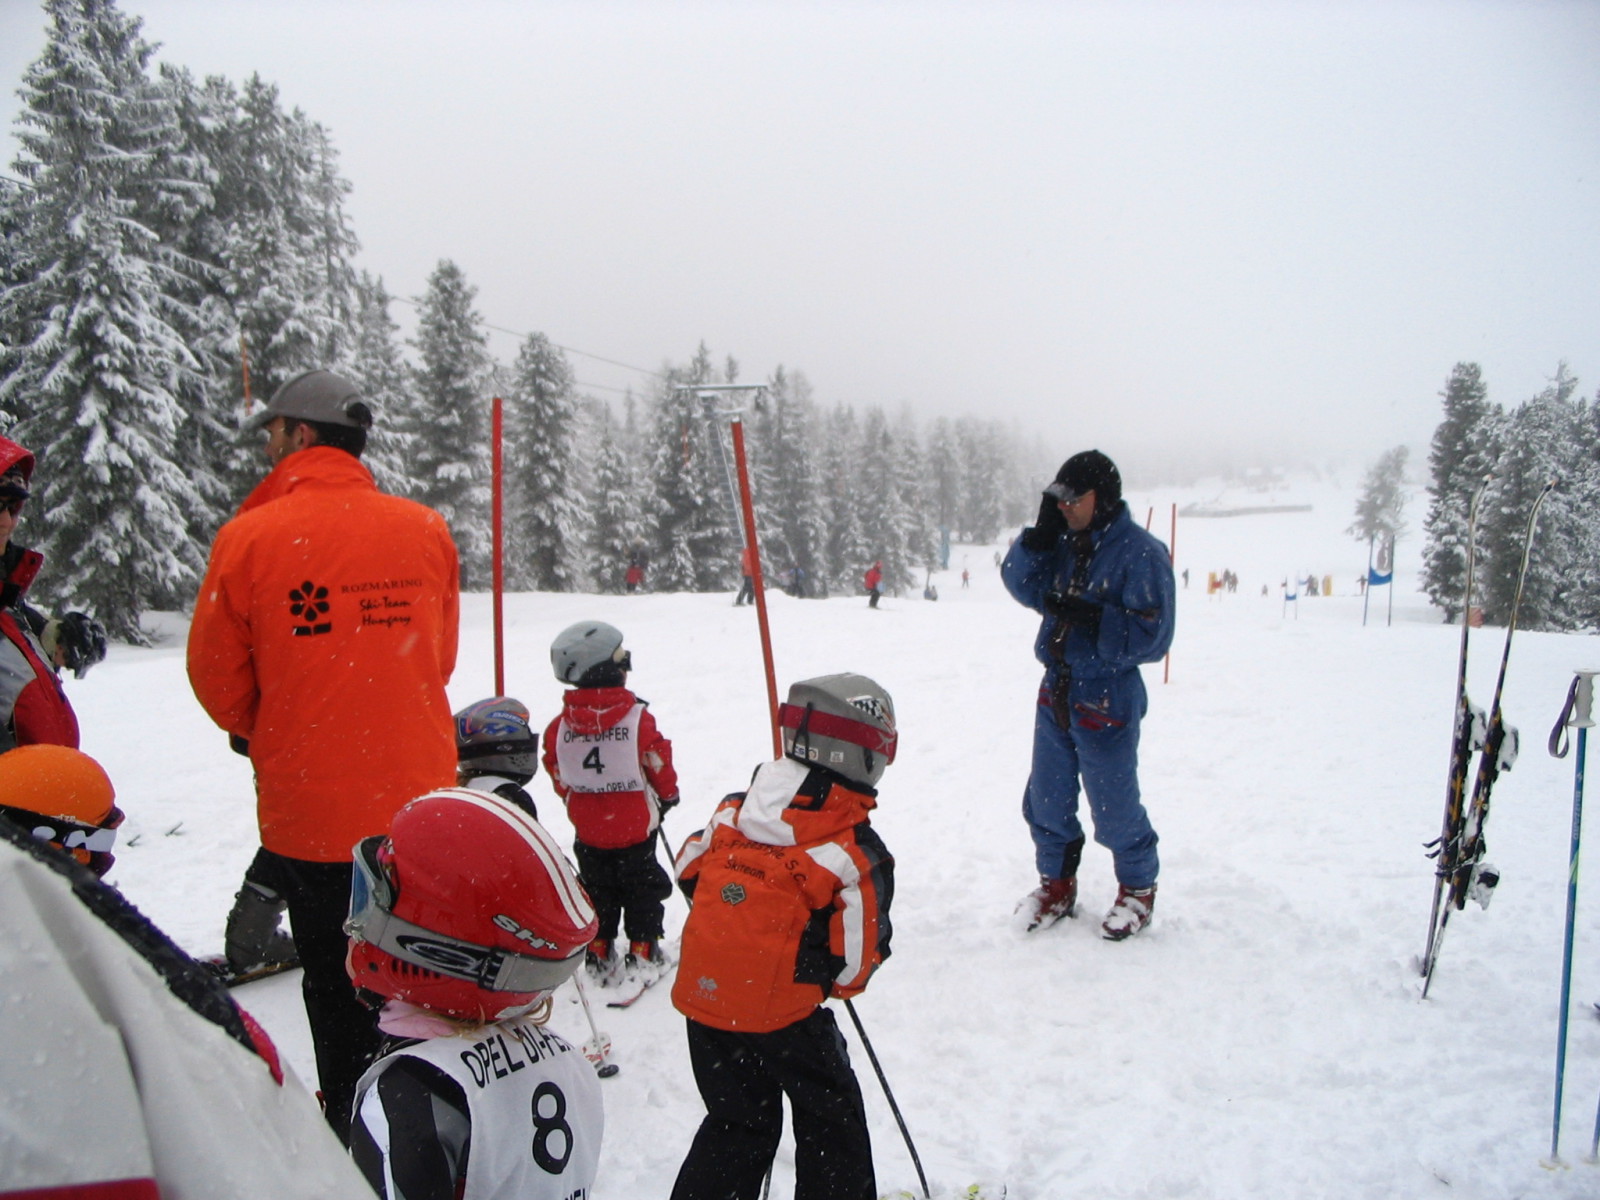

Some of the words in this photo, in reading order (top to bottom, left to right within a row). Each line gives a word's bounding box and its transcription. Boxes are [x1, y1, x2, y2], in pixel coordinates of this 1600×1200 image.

[362, 614, 411, 629] Hungary
[582, 746, 605, 774] 4
[460, 1033, 525, 1089] OPEL
[531, 1081, 574, 1175] 8
